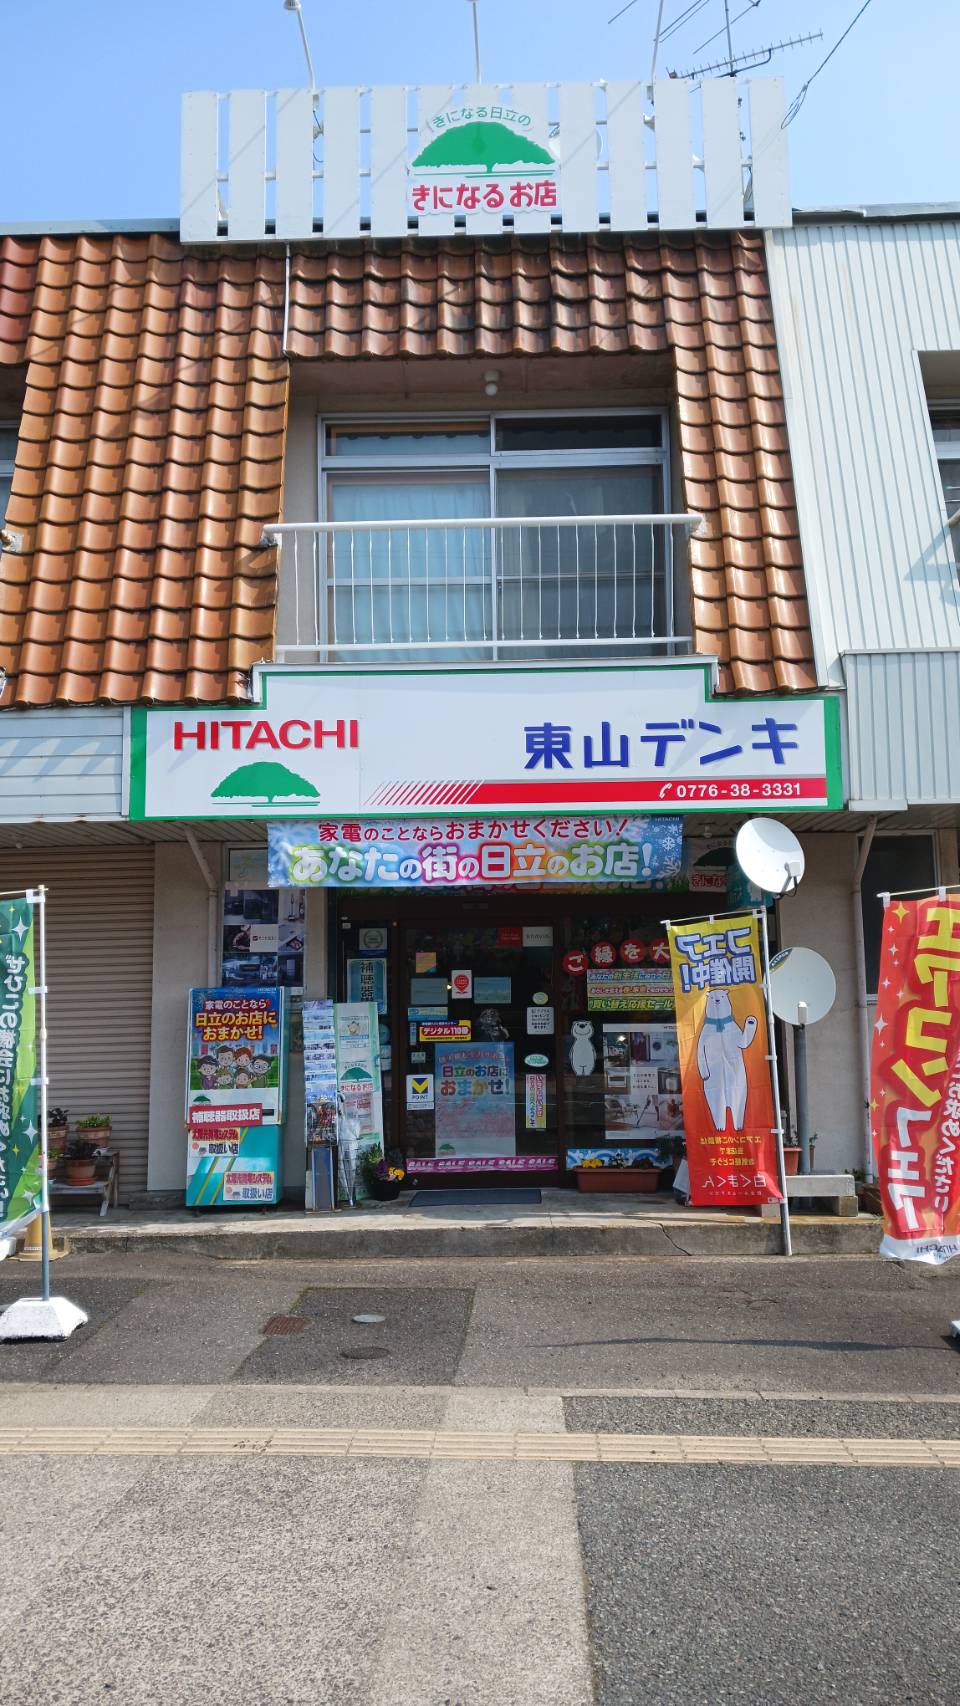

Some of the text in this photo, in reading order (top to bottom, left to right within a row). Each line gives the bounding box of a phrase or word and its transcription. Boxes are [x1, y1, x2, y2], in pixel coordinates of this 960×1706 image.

[433, 106, 531, 129] きになる日立の
[412, 180, 557, 211] きになるお店
[173, 719, 359, 751] HITACHI
[523, 718, 798, 769] 東山デンキ
[676, 782, 802, 798] 0776-38-3331
[318, 818, 629, 842] 家電のことならおまかせください!
[292, 842, 653, 882] あなたの街の日立のお店!
[195, 1010, 277, 1026] 日立のお店に
[203, 1026, 263, 1041] おまかせ!
[442, 1065, 509, 1078] 日立のお店に
[440, 1079, 511, 1096] おまかせ!
